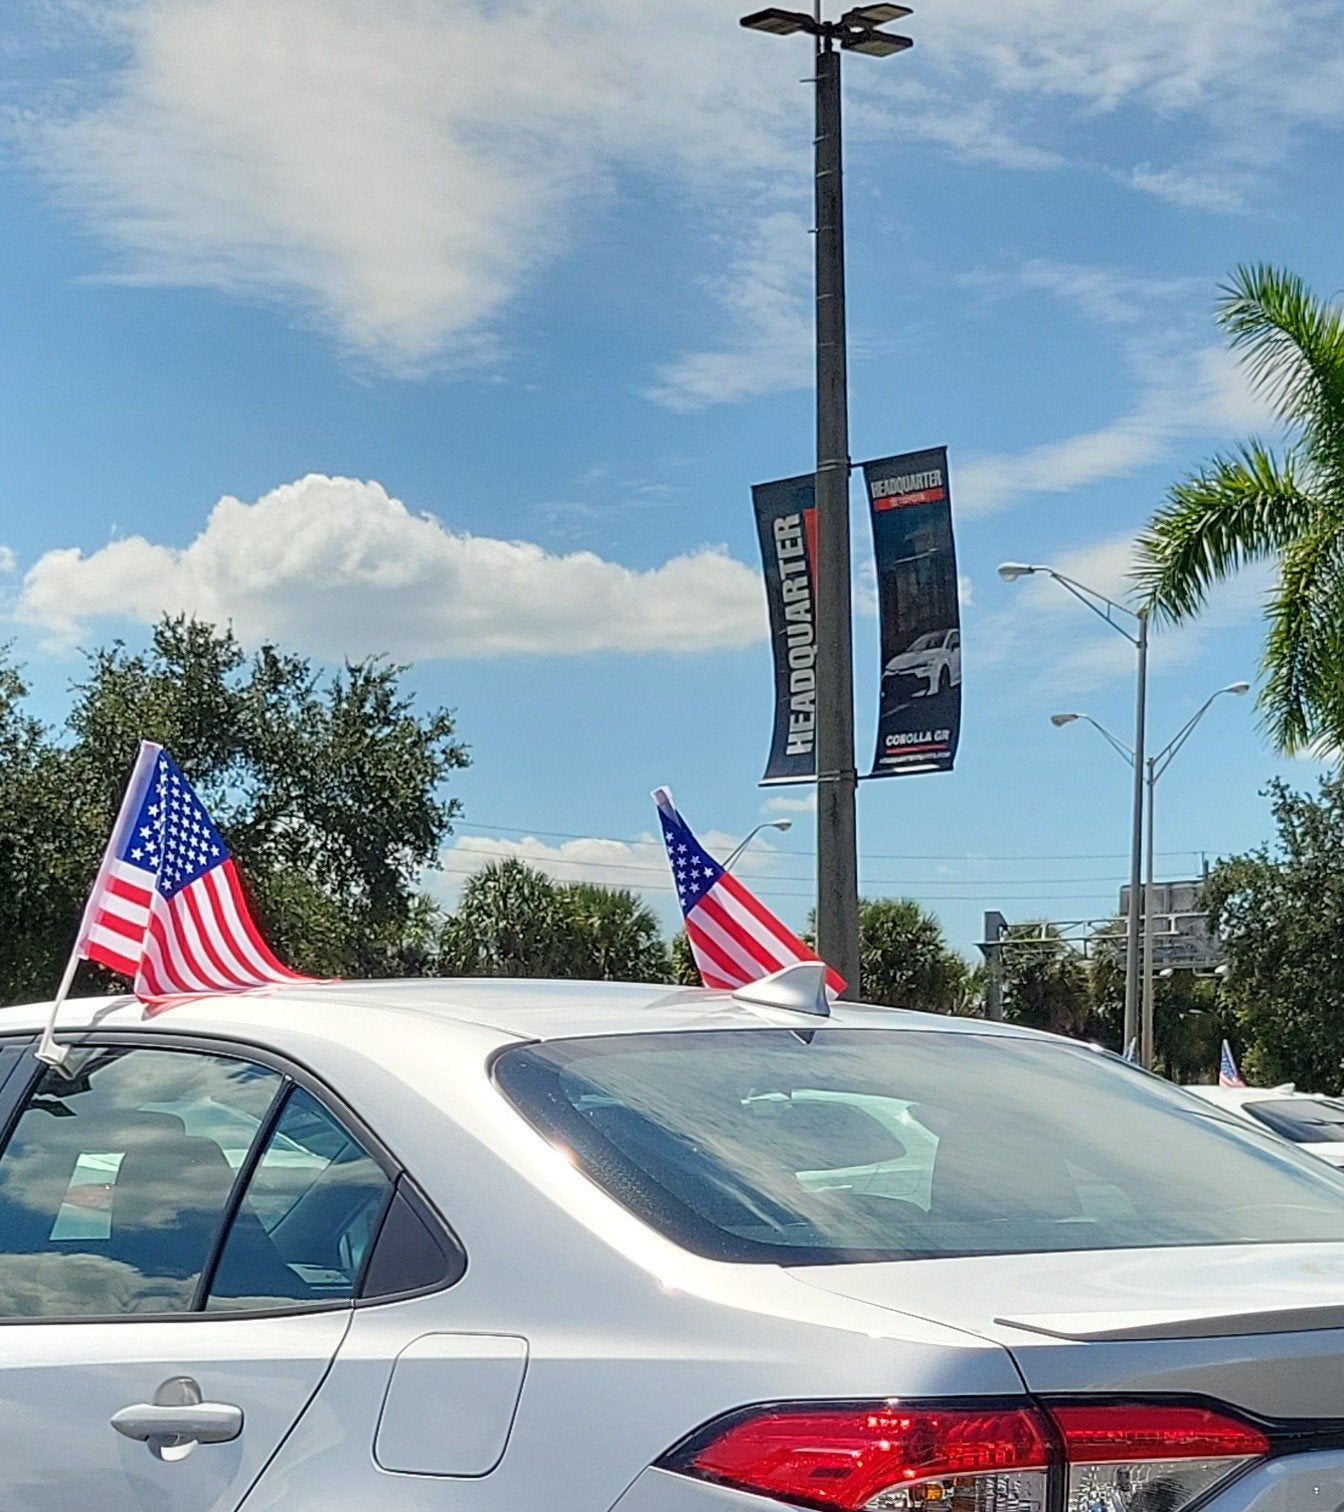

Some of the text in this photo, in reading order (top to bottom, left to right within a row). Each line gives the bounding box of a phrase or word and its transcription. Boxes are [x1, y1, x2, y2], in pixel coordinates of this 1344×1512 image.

[871, 469, 943, 499] HEADQUARTER
[772, 512, 816, 756] HEADQUARTER
[885, 731, 932, 746] COROLLA
